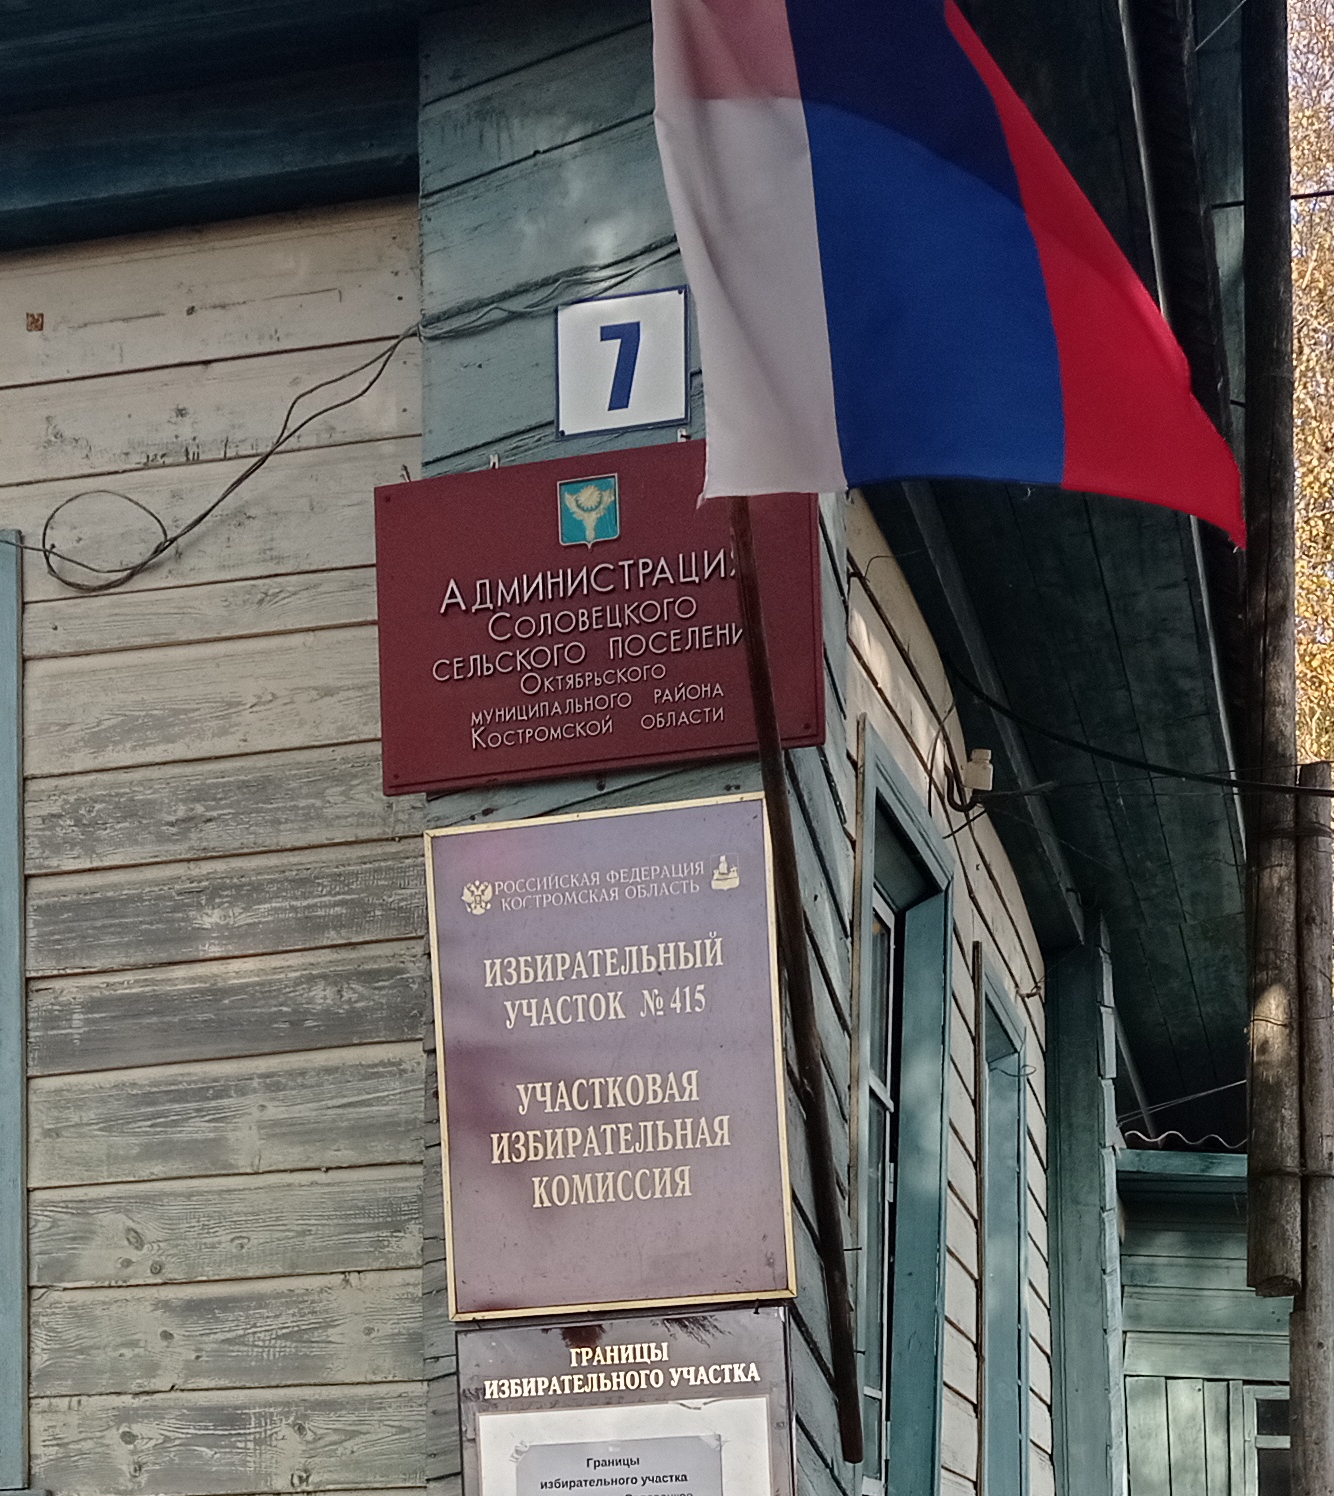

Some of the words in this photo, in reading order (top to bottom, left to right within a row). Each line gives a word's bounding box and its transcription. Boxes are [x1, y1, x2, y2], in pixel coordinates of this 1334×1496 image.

[599, 320, 642, 413] 7
[488, 596, 697, 641] СОЛОВЕЦКОГО
[432, 641, 586, 682] СЕЛЬСКОГО
[608, 622, 743, 660] ПОСЕЛЕНИ
[520, 663, 666, 695] ОКТЯБРЬСКОГО
[470, 692, 632, 727] МУНИЦИПАЛЬНОГО
[653, 682, 724, 705] РАЙОНА
[471, 714, 614, 750] КОСТРОМСКОЙ
[640, 707, 724, 730] ОБЛАСТИ
[494, 872, 601, 896] РОССИЙСКАЯ
[606, 861, 705, 885] ФЕДЕРАЦИЯ
[500, 887, 620, 912] КОСТРОМСКАЯ
[625, 879, 701, 900] ОБЛАСТЬ
[483, 931, 724, 988] ИЗБИРАТЕЛЬНЫЙ
[503, 991, 627, 1030] УЧАСТОК
[669, 983, 707, 1015] 415
[516, 1069, 700, 1116] УЧАСТКОВАЯ
[490, 1115, 732, 1165] ИЗБИРАТЕЛЬНАЯ
[531, 1165, 693, 1209] КОМИССИЯ
[569, 1341, 670, 1368] ГРАНИЦЫ
[483, 1369, 664, 1400] ИЗБИРАТЕЛЬНОГО
[668, 1362, 761, 1389] УЧАСТКА
[540, 1475, 639, 1491] избирательного
[640, 1473, 688, 1487] участка
[586, 1456, 640, 1471] Границы
